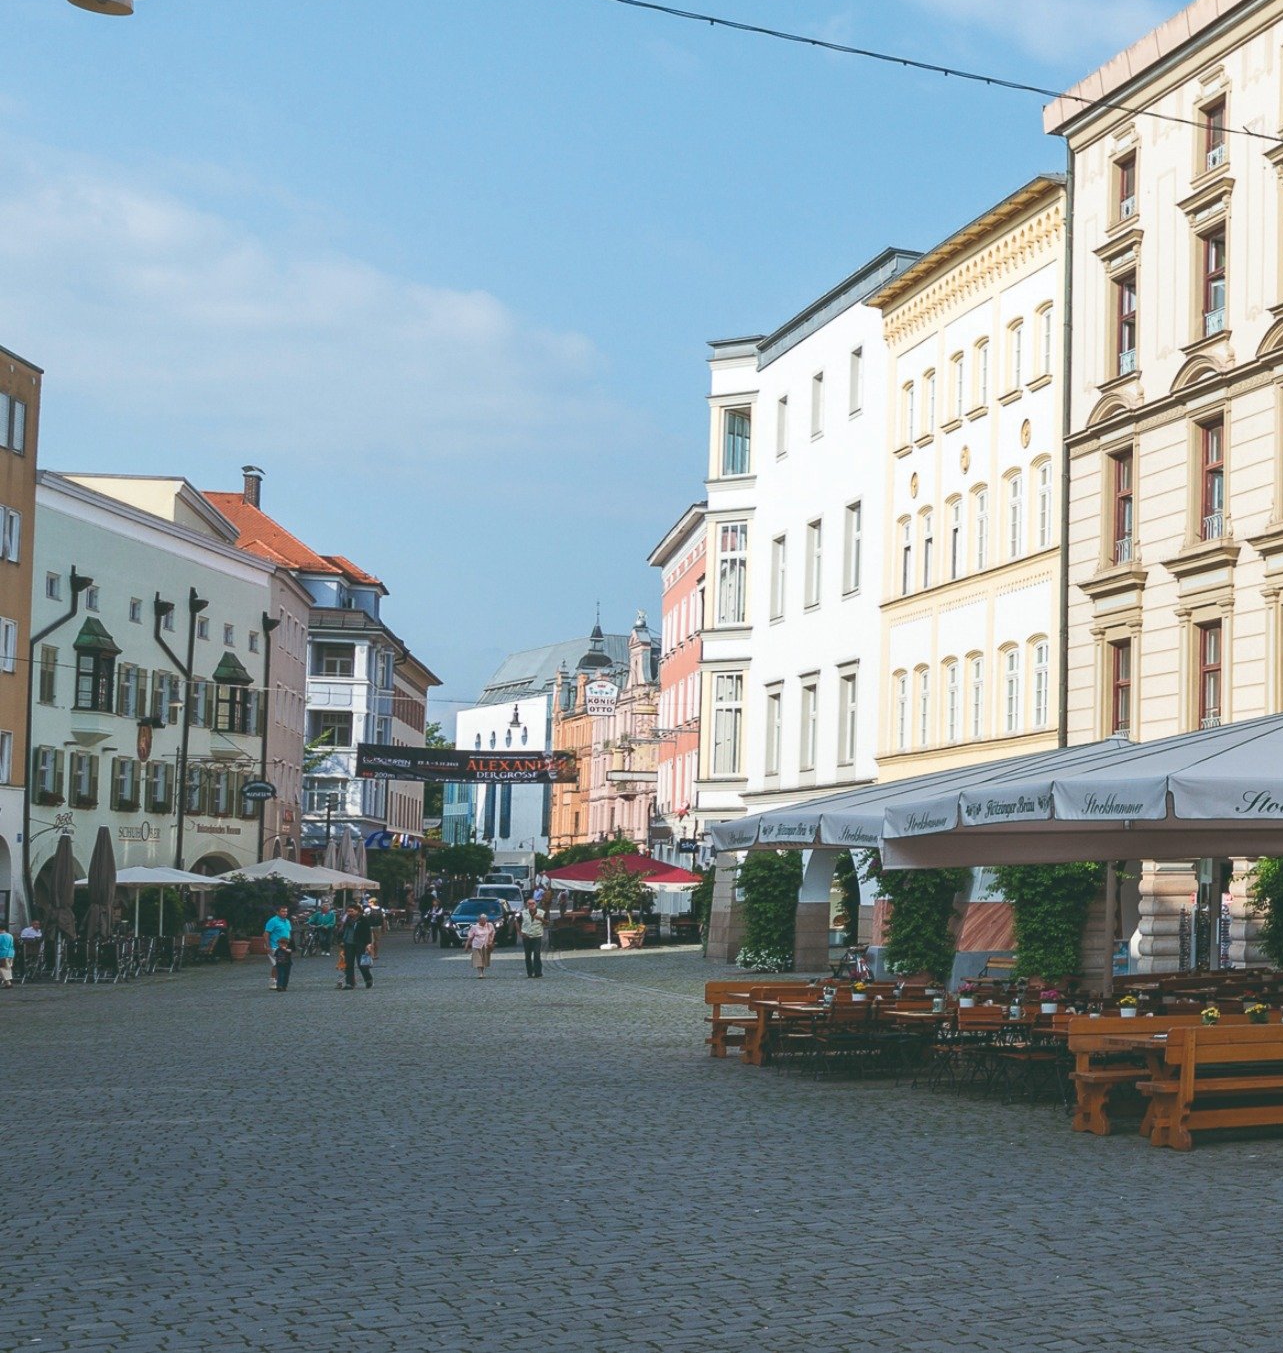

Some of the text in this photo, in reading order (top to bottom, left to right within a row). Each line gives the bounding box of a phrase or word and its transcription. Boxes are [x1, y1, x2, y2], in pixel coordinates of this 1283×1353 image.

[588, 697, 616, 705] KÖNIG
[476, 771, 499, 780] DER
[499, 771, 538, 780] GROSSE
[984, 796, 1035, 819] Flötzinger Bräu
[1081, 793, 1144, 815] Stockhammer
[904, 812, 948, 832] Stockhammer
[681, 842, 697, 850] sky
